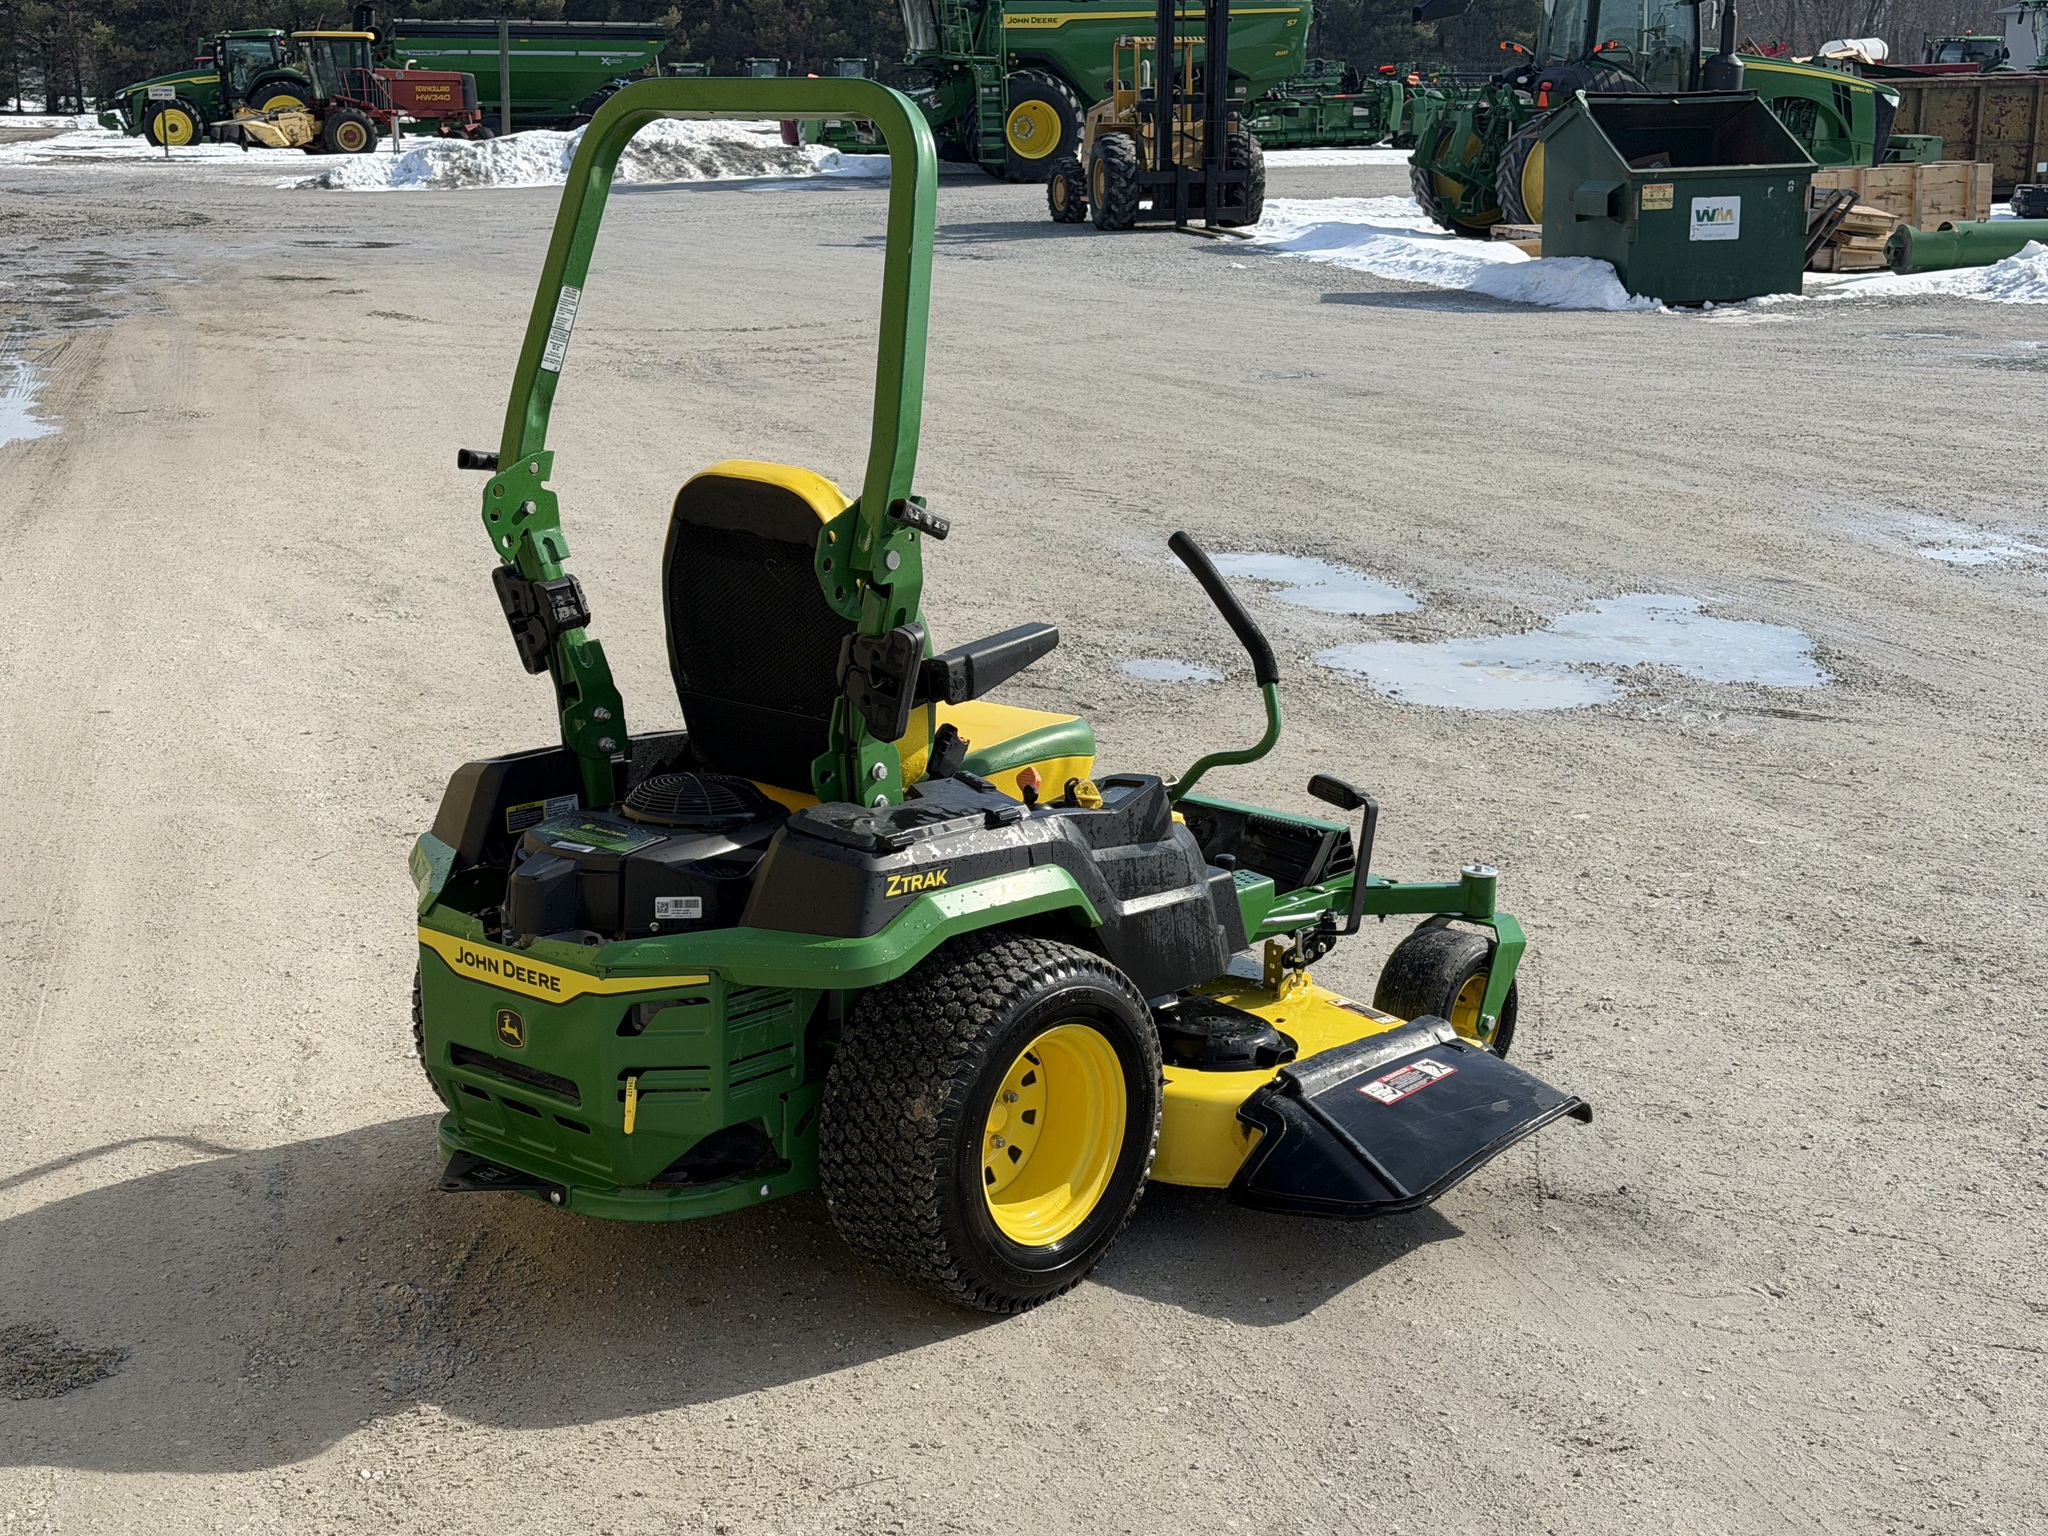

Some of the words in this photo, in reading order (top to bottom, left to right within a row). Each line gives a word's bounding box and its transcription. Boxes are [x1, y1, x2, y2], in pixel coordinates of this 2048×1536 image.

[1007, 16, 1030, 24] JOHN
[1030, 16, 1059, 24] DEERE
[1286, 19, 1298, 27] S7
[885, 867, 949, 897] ZTRAK
[454, 946, 500, 975] JOHN
[502, 958, 562, 993] DEERE
